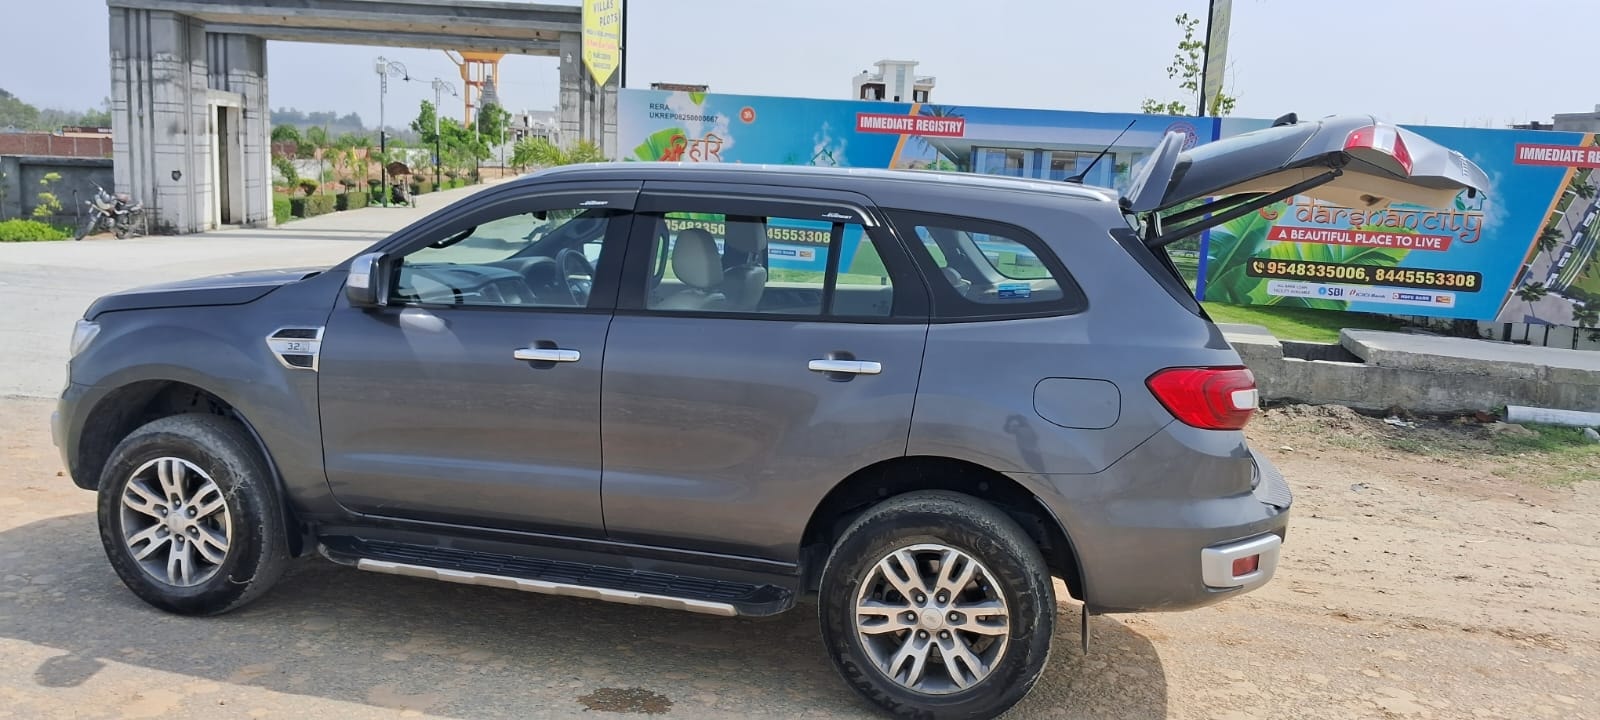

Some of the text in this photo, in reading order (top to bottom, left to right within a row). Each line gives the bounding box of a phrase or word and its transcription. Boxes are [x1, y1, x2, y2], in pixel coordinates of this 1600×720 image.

[600, 13, 618, 27] PLOTS
[649, 103, 670, 111] RERA
[860, 116, 962, 133] IMMEDIATE REGISTRY
[1520, 147, 1585, 162] IMMEDIATE
[1278, 229, 1441, 249] A BEAUTIFUL PLACE TO LIVE
[1267, 261, 1476, 287] 9548335006, 8445553308
[1327, 287, 1344, 297] SBI
